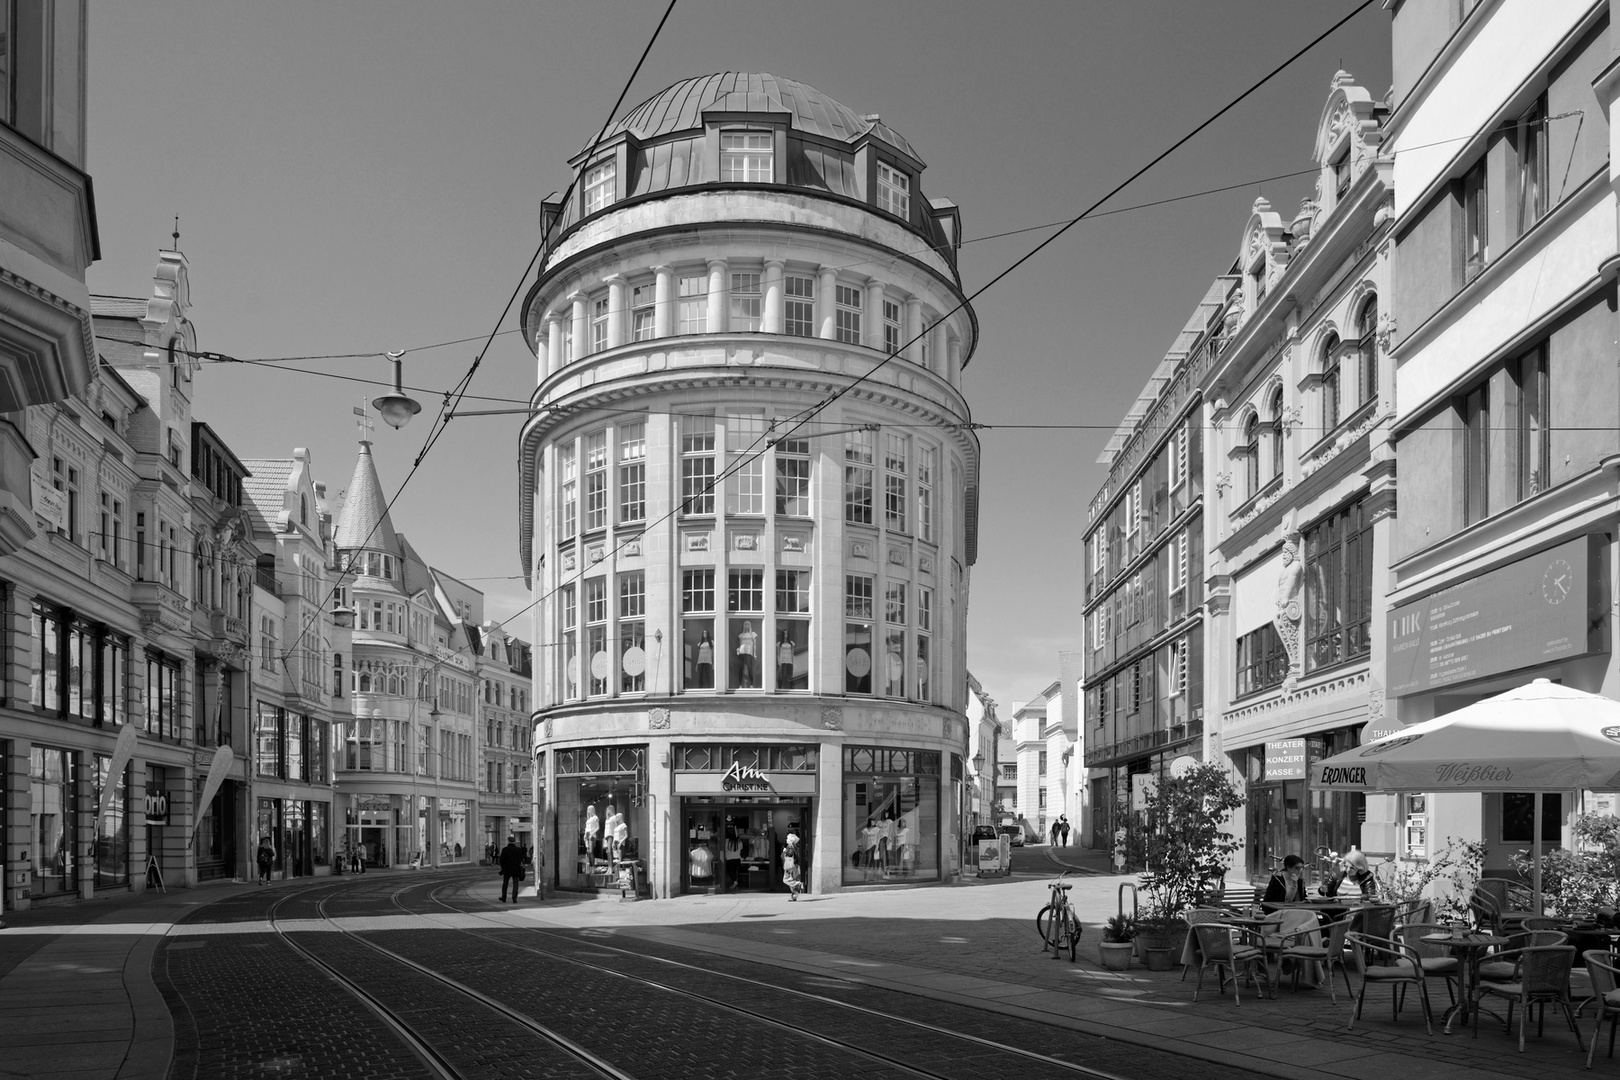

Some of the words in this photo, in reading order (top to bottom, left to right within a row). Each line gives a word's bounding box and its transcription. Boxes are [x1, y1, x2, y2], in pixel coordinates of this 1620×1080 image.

[1266, 739, 1304, 750] THEATER
[1266, 754, 1304, 764] KONZERT
[720, 760, 770, 783] Ann
[1266, 767, 1293, 776] KASSE
[1321, 766, 1367, 785] ERDINGER
[1436, 762, 1513, 784] Weißbier
[722, 781, 768, 792] CHRISTINE
